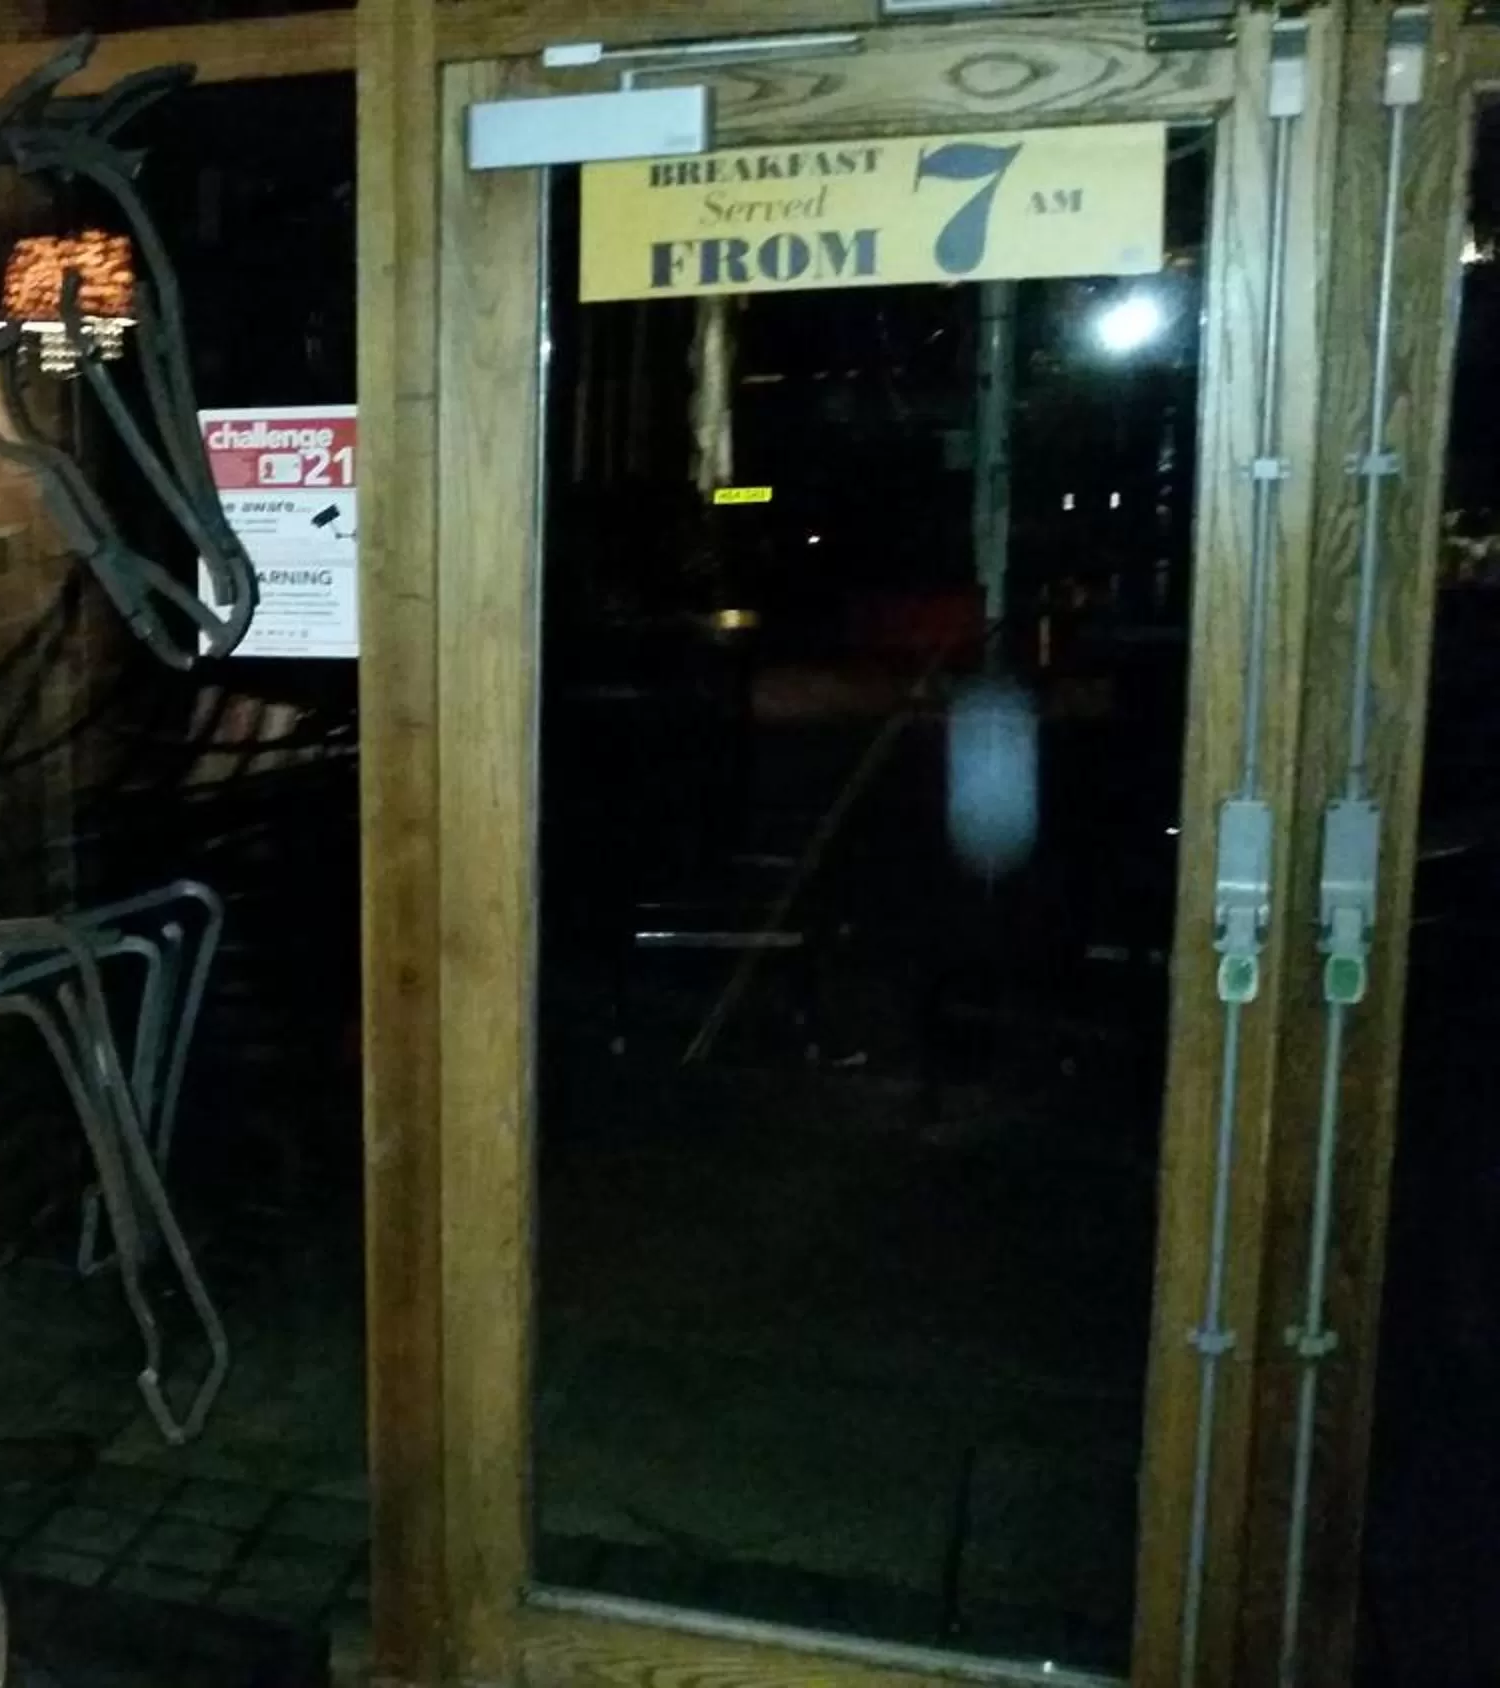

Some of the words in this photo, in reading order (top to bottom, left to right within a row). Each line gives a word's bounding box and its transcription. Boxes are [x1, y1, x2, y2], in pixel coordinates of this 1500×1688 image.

[649, 148, 882, 187] BREAKFAST
[699, 184, 827, 226] Served
[913, 142, 1023, 275] 7
[1028, 189, 1083, 214] AM
[651, 228, 882, 288] FROM
[208, 422, 333, 453] challenge
[304, 447, 353, 486] 21
[257, 571, 333, 585] ARNING
